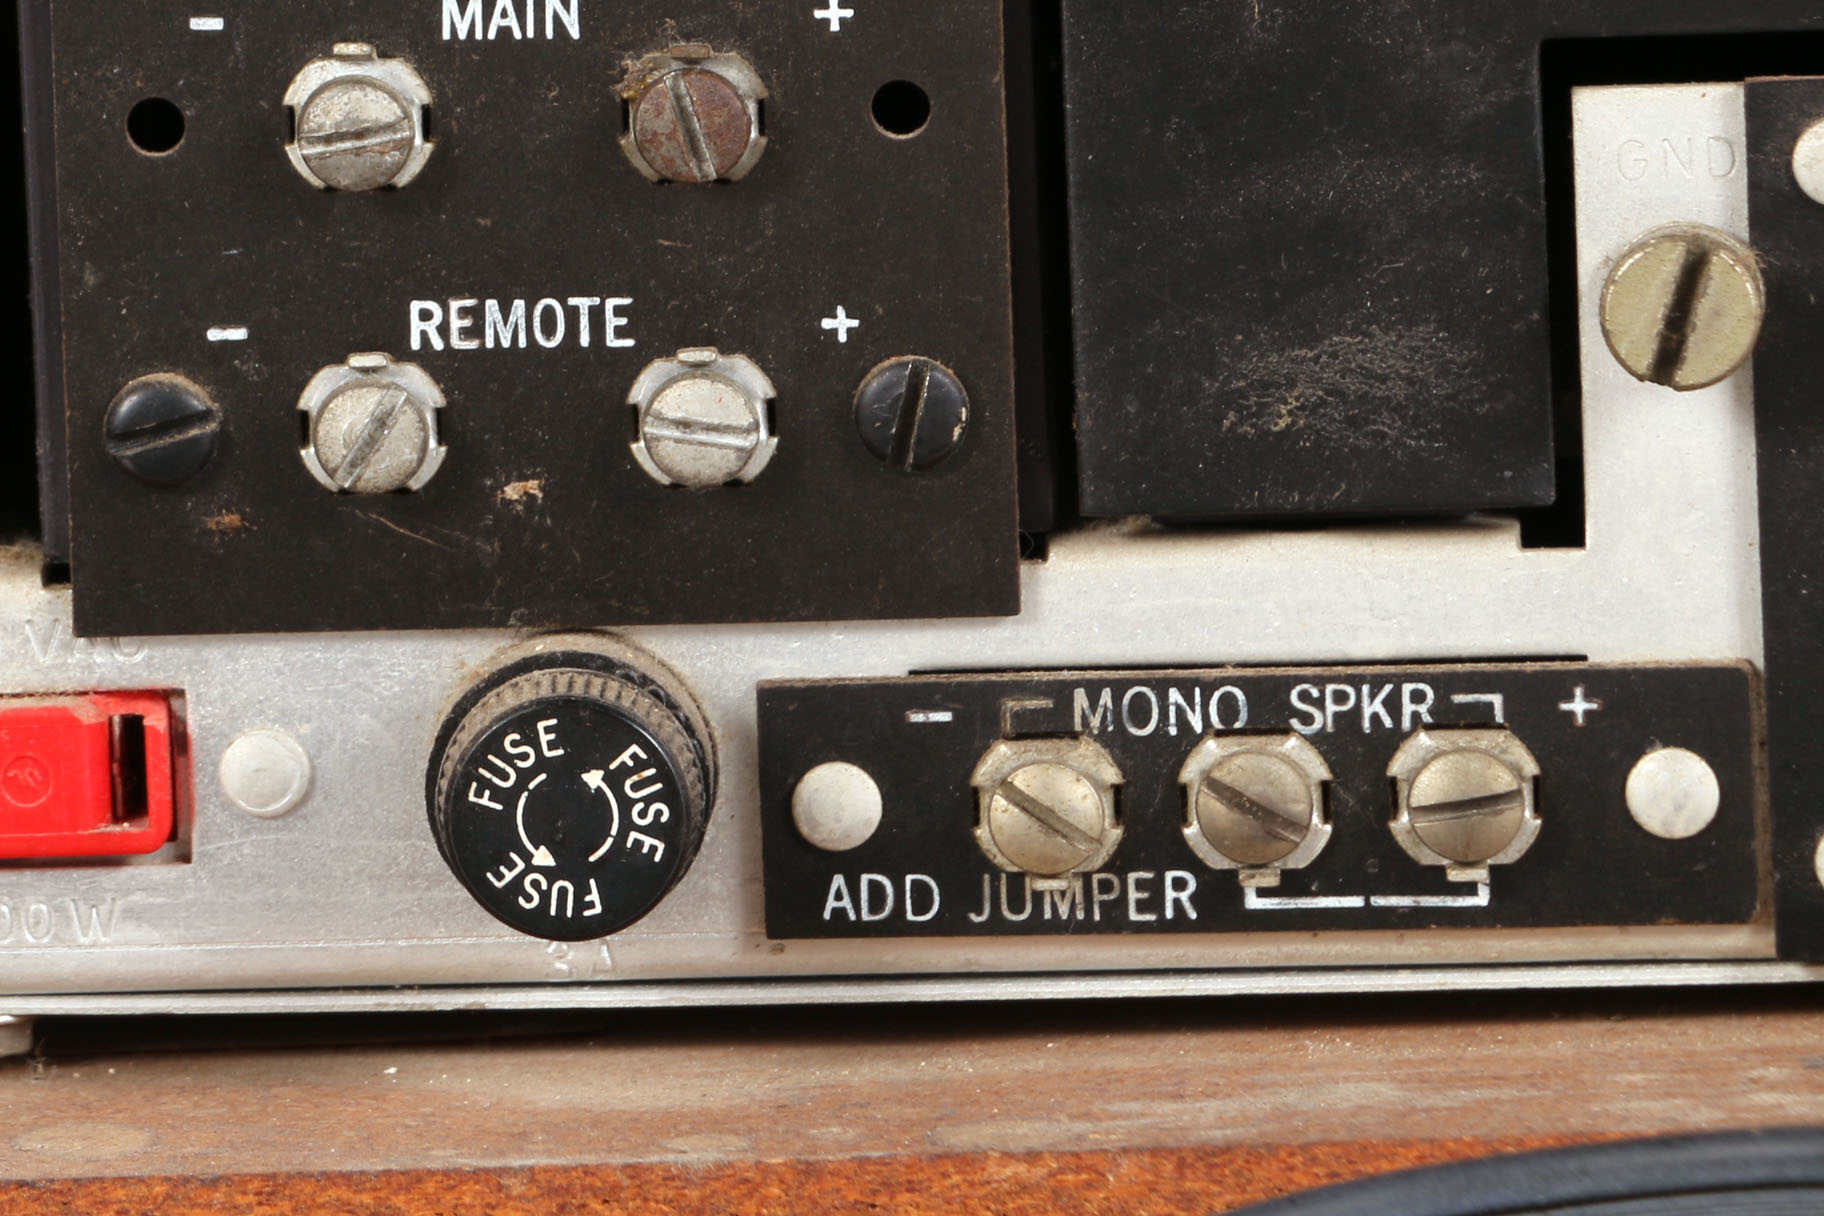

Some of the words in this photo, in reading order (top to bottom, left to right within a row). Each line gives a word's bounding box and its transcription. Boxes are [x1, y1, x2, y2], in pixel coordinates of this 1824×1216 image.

[1616, 136, 1736, 181] GND
[409, 296, 636, 352] REMOTE
[1073, 684, 1248, 737] MONO
[1288, 682, 1435, 735] SPKR
[467, 718, 565, 811] FUSE
[608, 743, 670, 863] FUSE
[485, 851, 603, 919] FUSE
[823, 873, 941, 922] ADD
[967, 870, 1198, 923] JUMPER
